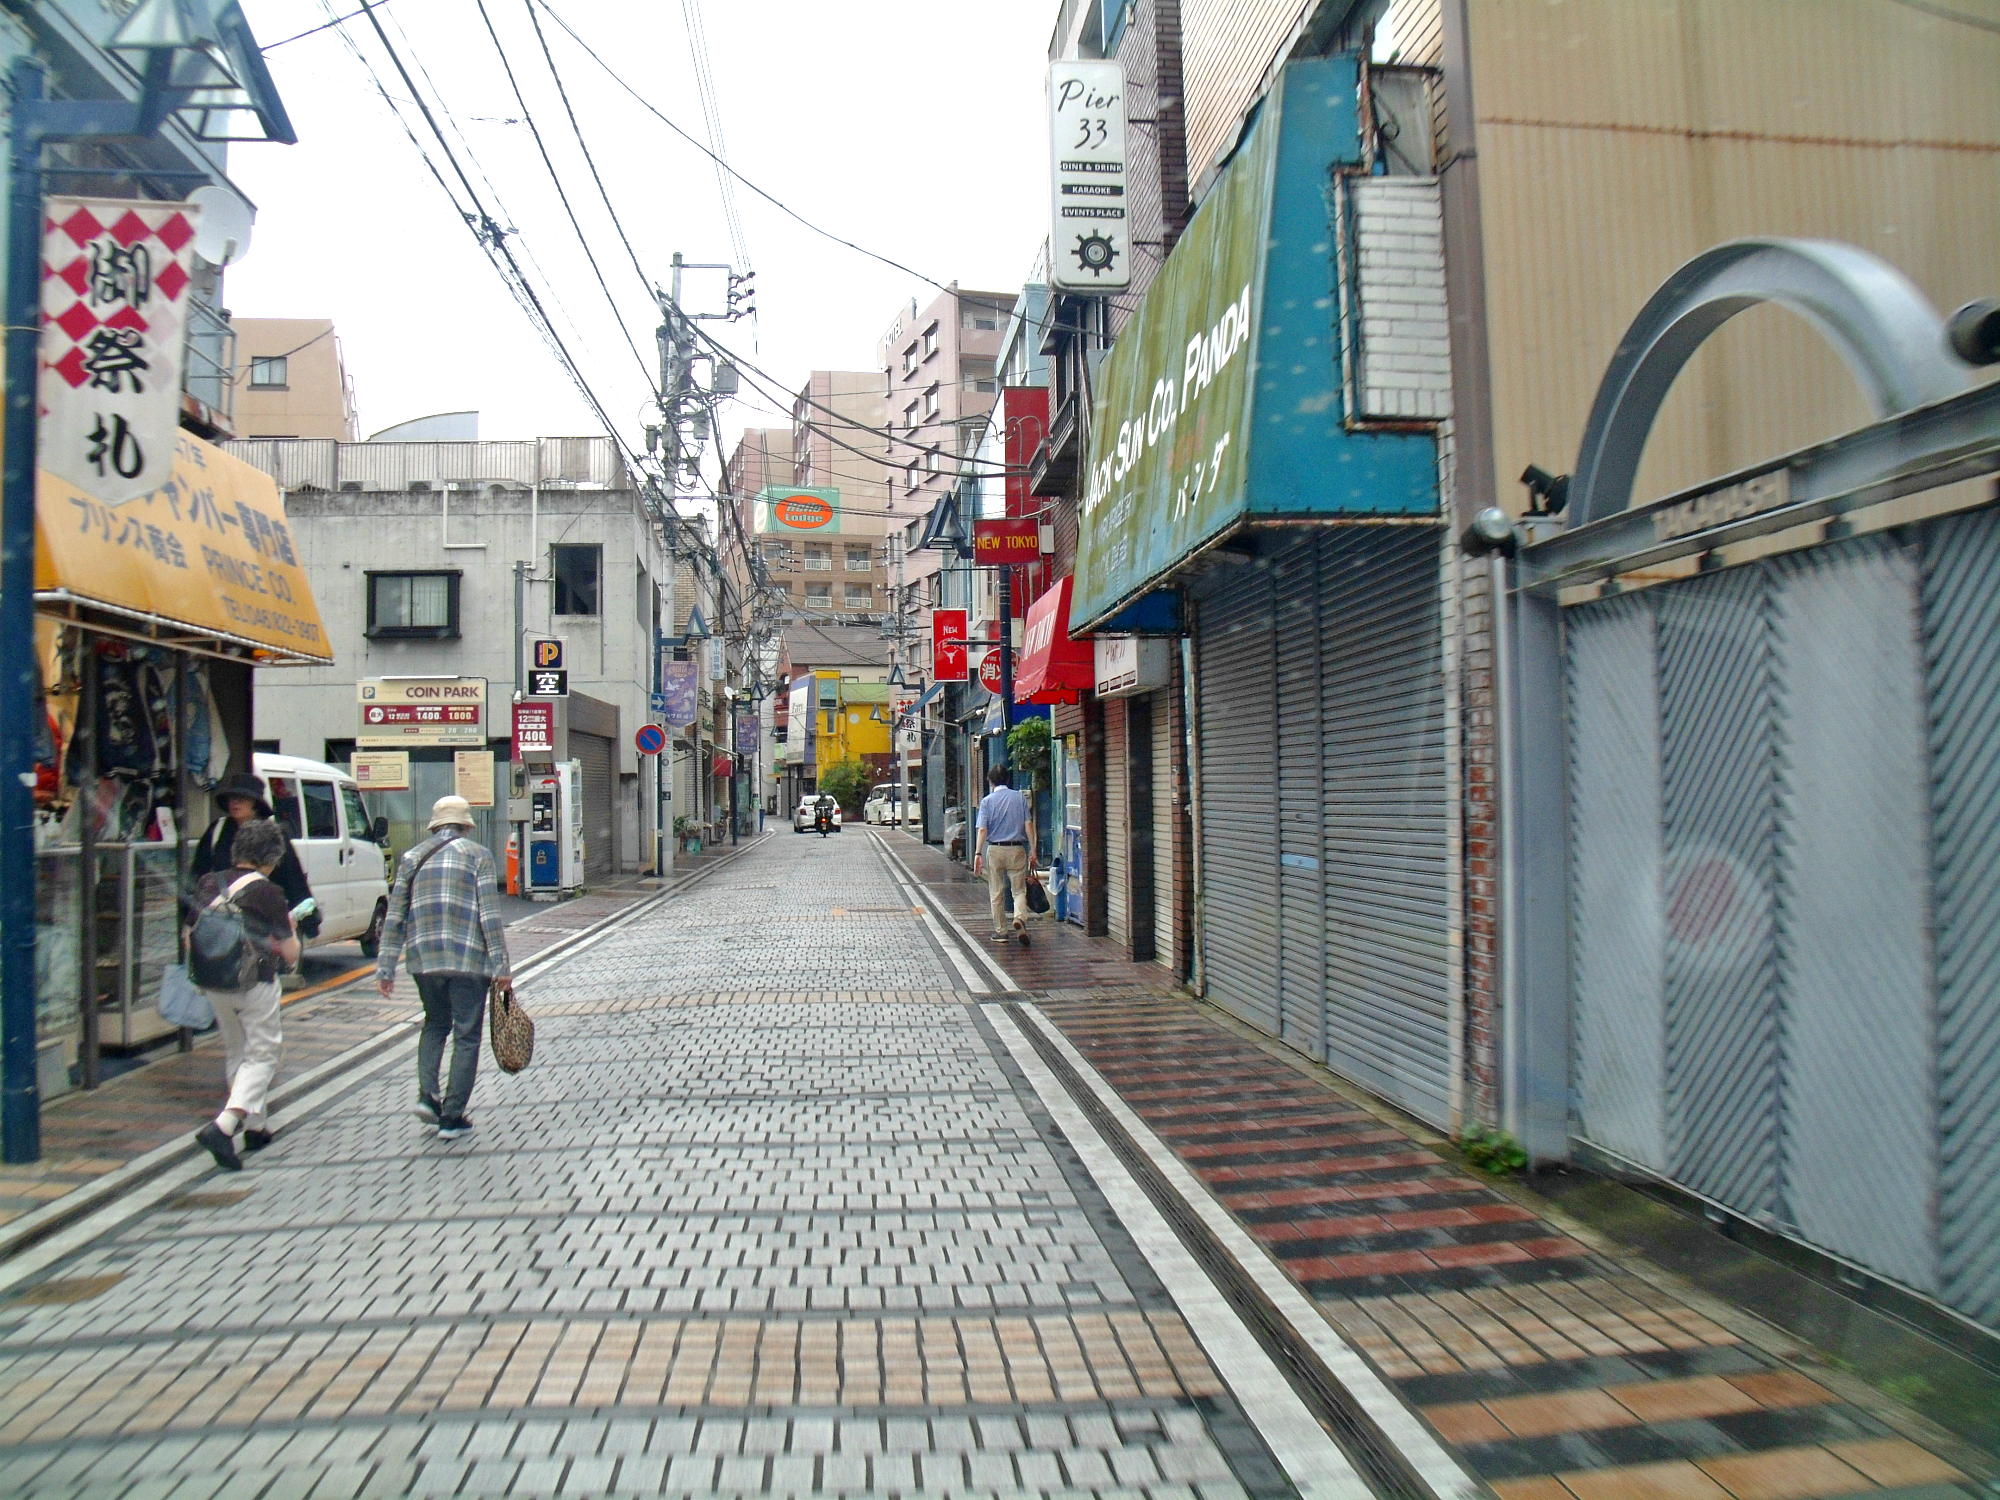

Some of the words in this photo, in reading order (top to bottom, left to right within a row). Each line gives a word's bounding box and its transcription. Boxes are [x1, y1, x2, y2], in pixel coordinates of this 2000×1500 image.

[1057, 79, 1120, 112] Pier
[1074, 118, 1108, 150] 33
[1062, 162, 1084, 171] DINE
[1085, 163, 1093, 171] &
[1094, 163, 1122, 172] DRINK
[1072, 185, 1111, 195] KARAOKE
[1064, 208, 1095, 217] EVENTS
[1096, 208, 1122, 218] PLACE
[1085, 450, 1115, 518] JACK
[1114, 411, 1147, 482] SUN
[1181, 282, 1250, 415] PANDA
[976, 536, 1001, 550] NEW
[1005, 535, 1038, 549] TOKYO
[200, 544, 269, 595] PRINCE
[405, 686, 441, 698] COIN
[443, 686, 479, 698] PARK
[535, 672, 560, 694] 空
